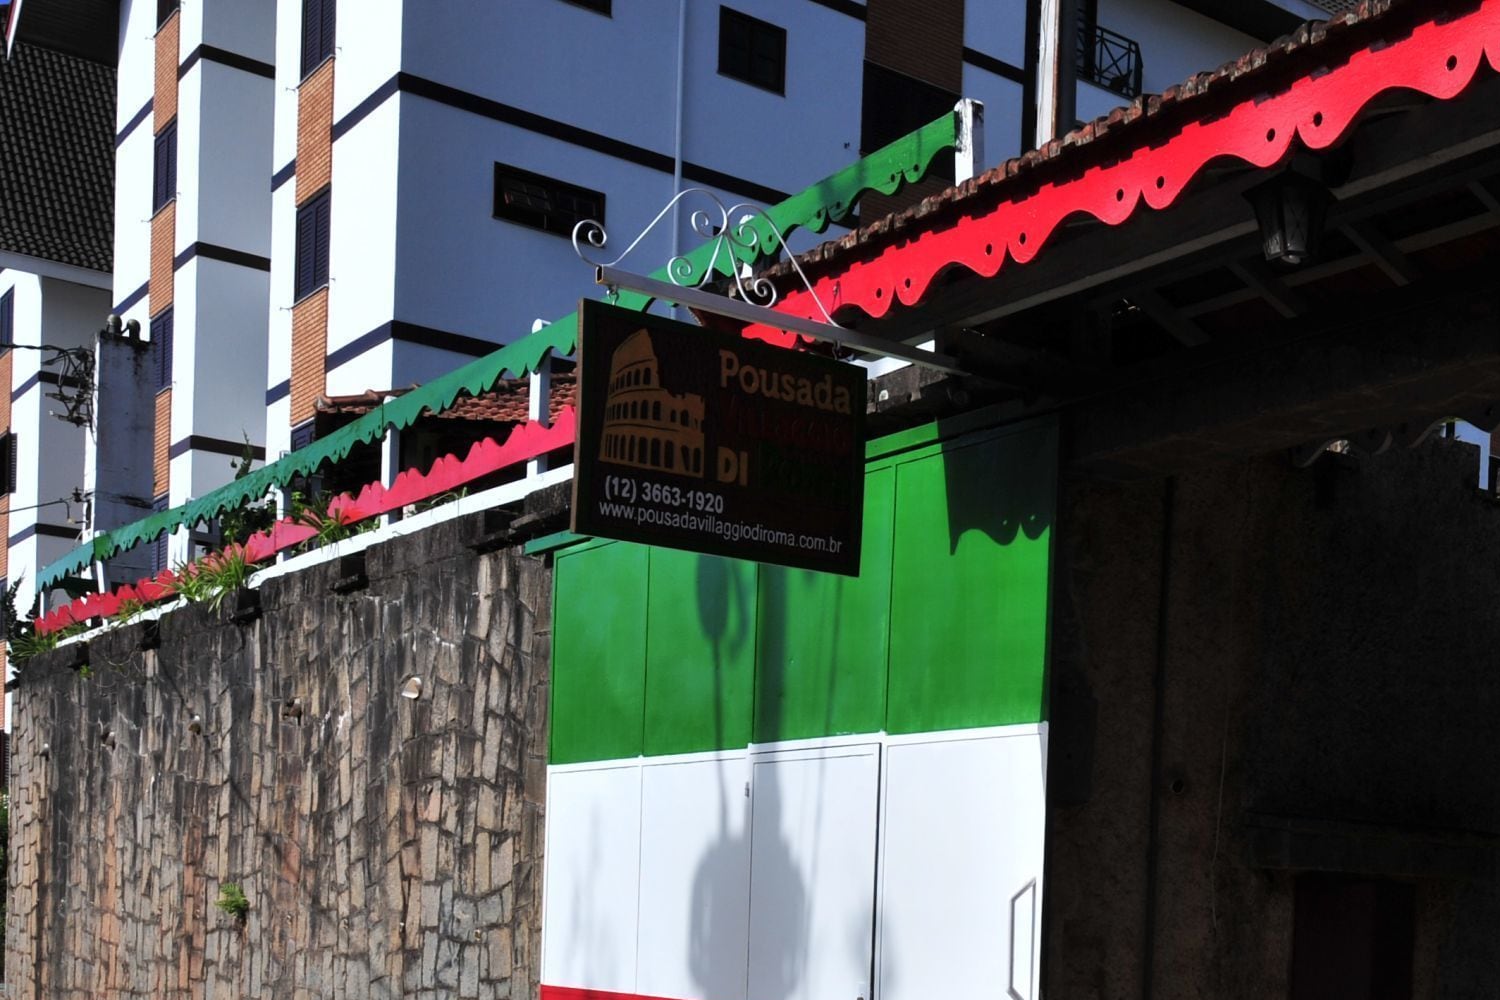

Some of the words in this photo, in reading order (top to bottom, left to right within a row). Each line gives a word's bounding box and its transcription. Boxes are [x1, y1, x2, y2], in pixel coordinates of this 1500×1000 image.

[718, 348, 852, 415] Pousada
[716, 446, 749, 487] DI
[604, 474, 637, 504] (12)
[642, 480, 724, 514] 3663-1920
[599, 500, 843, 555] www.pousadavillaggiodiroma.com.br
